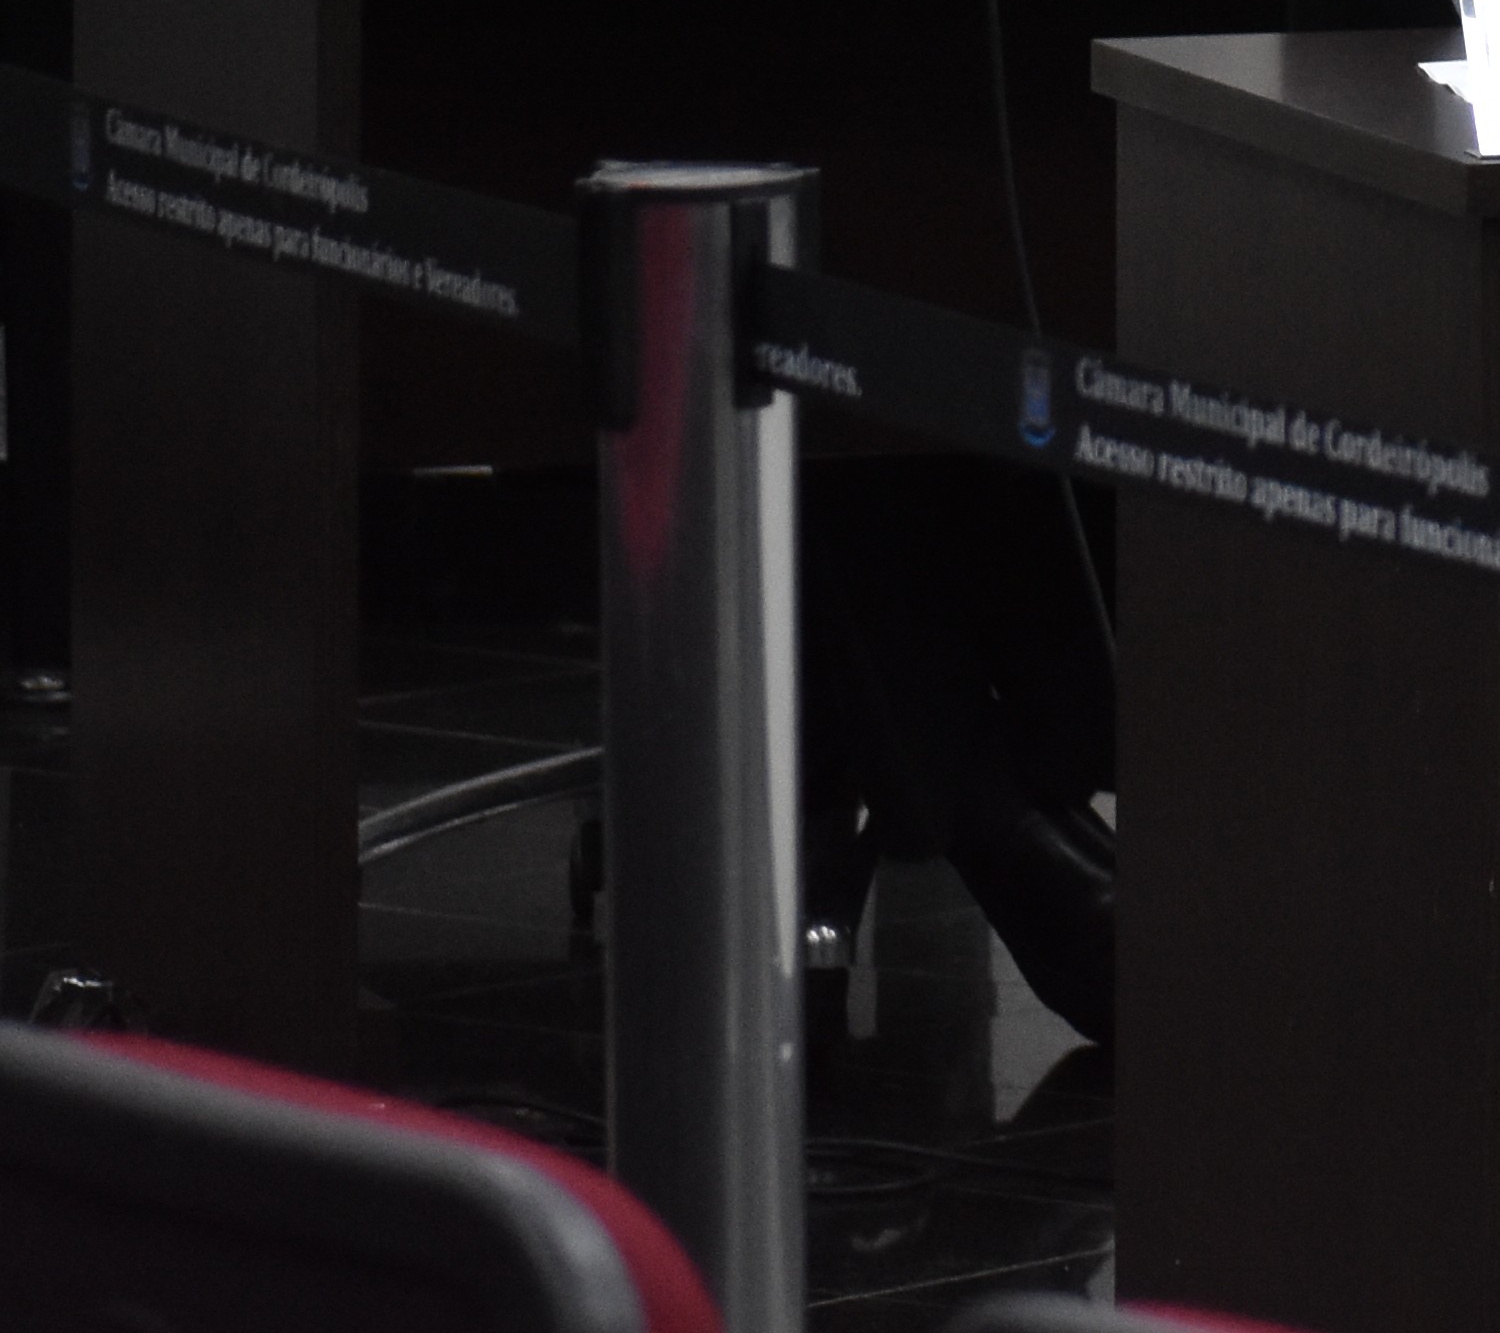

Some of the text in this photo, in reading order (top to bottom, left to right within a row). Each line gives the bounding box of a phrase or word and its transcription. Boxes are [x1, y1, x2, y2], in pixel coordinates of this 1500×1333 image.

[240, 145, 260, 183] de
[1073, 424, 1155, 478] Acesso
[1157, 452, 1247, 503] restrito
[1250, 476, 1336, 521] apenas
[1339, 498, 1395, 542] para
[1076, 357, 1489, 498] Câmara Municipal de Cordeirópolis
